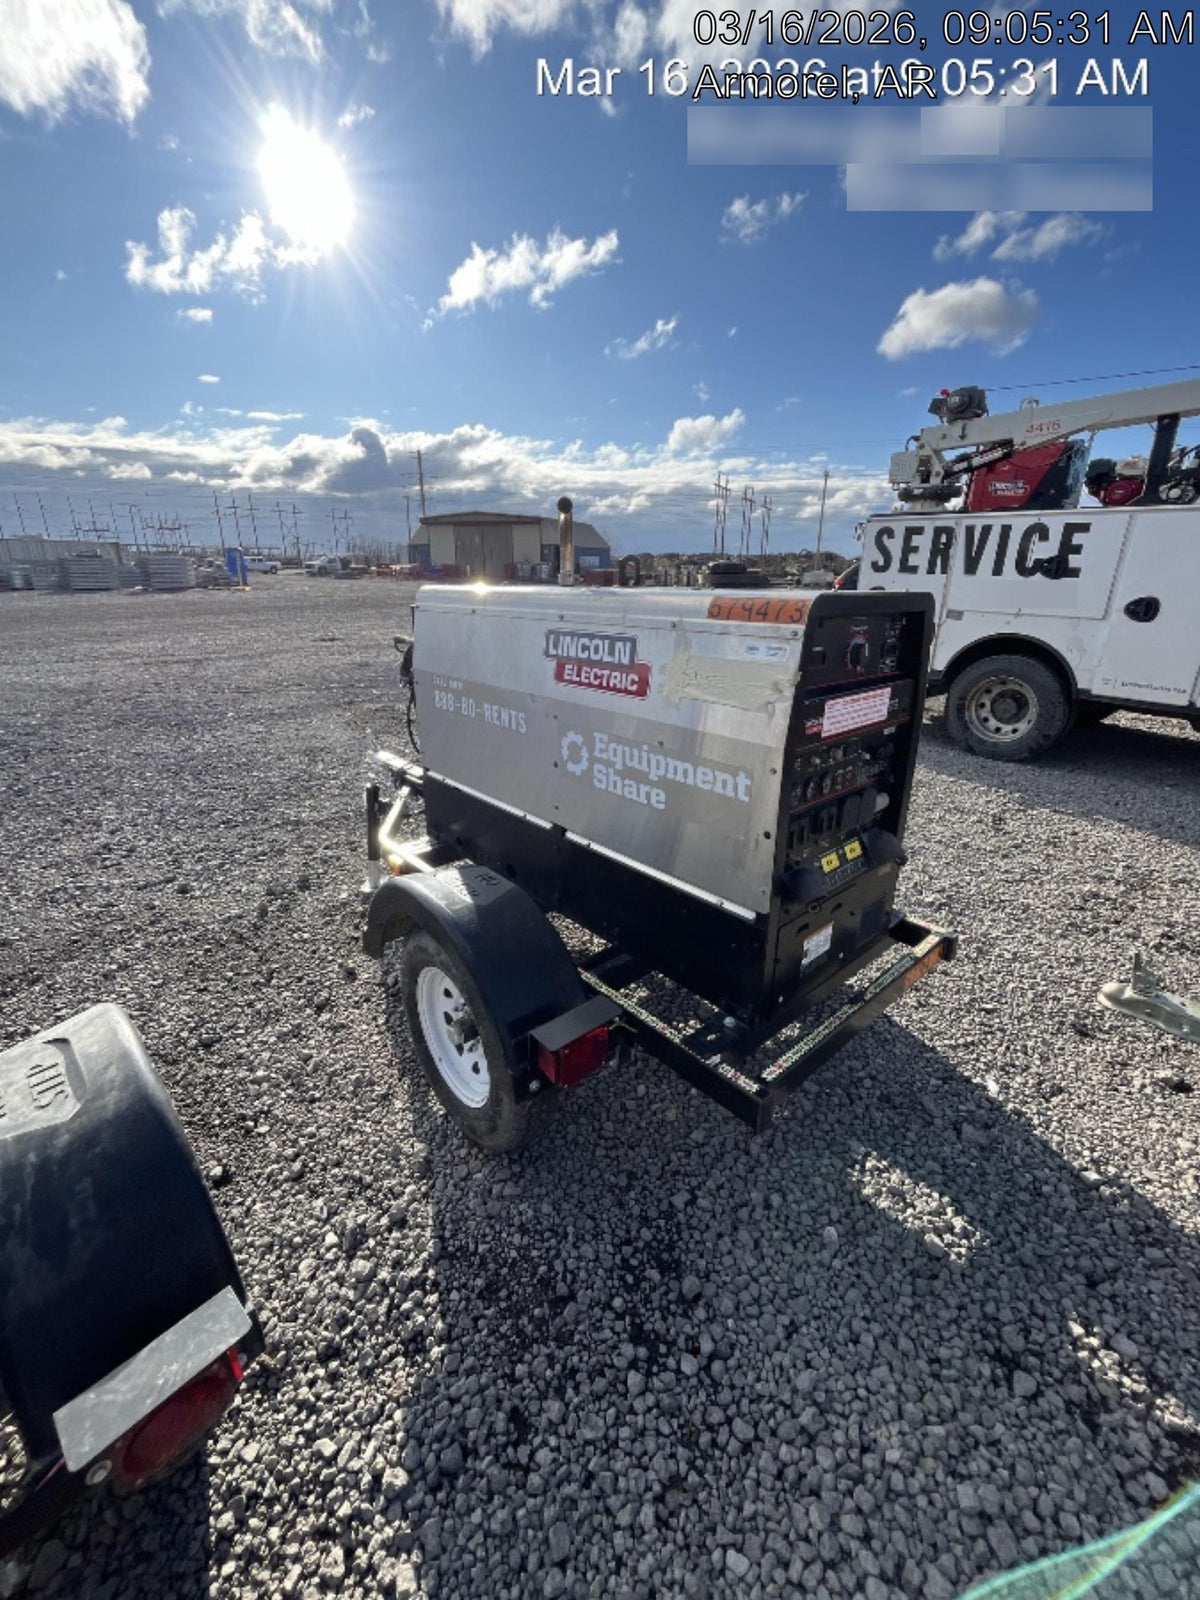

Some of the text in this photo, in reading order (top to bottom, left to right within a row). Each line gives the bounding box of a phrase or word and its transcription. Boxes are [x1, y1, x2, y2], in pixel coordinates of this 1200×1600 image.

[870, 522, 1093, 580] SERVICE
[548, 633, 632, 665] LINCOLN
[562, 663, 639, 691] ELECTRIC
[593, 731, 751, 803] Equipment
[593, 763, 667, 810] Share
